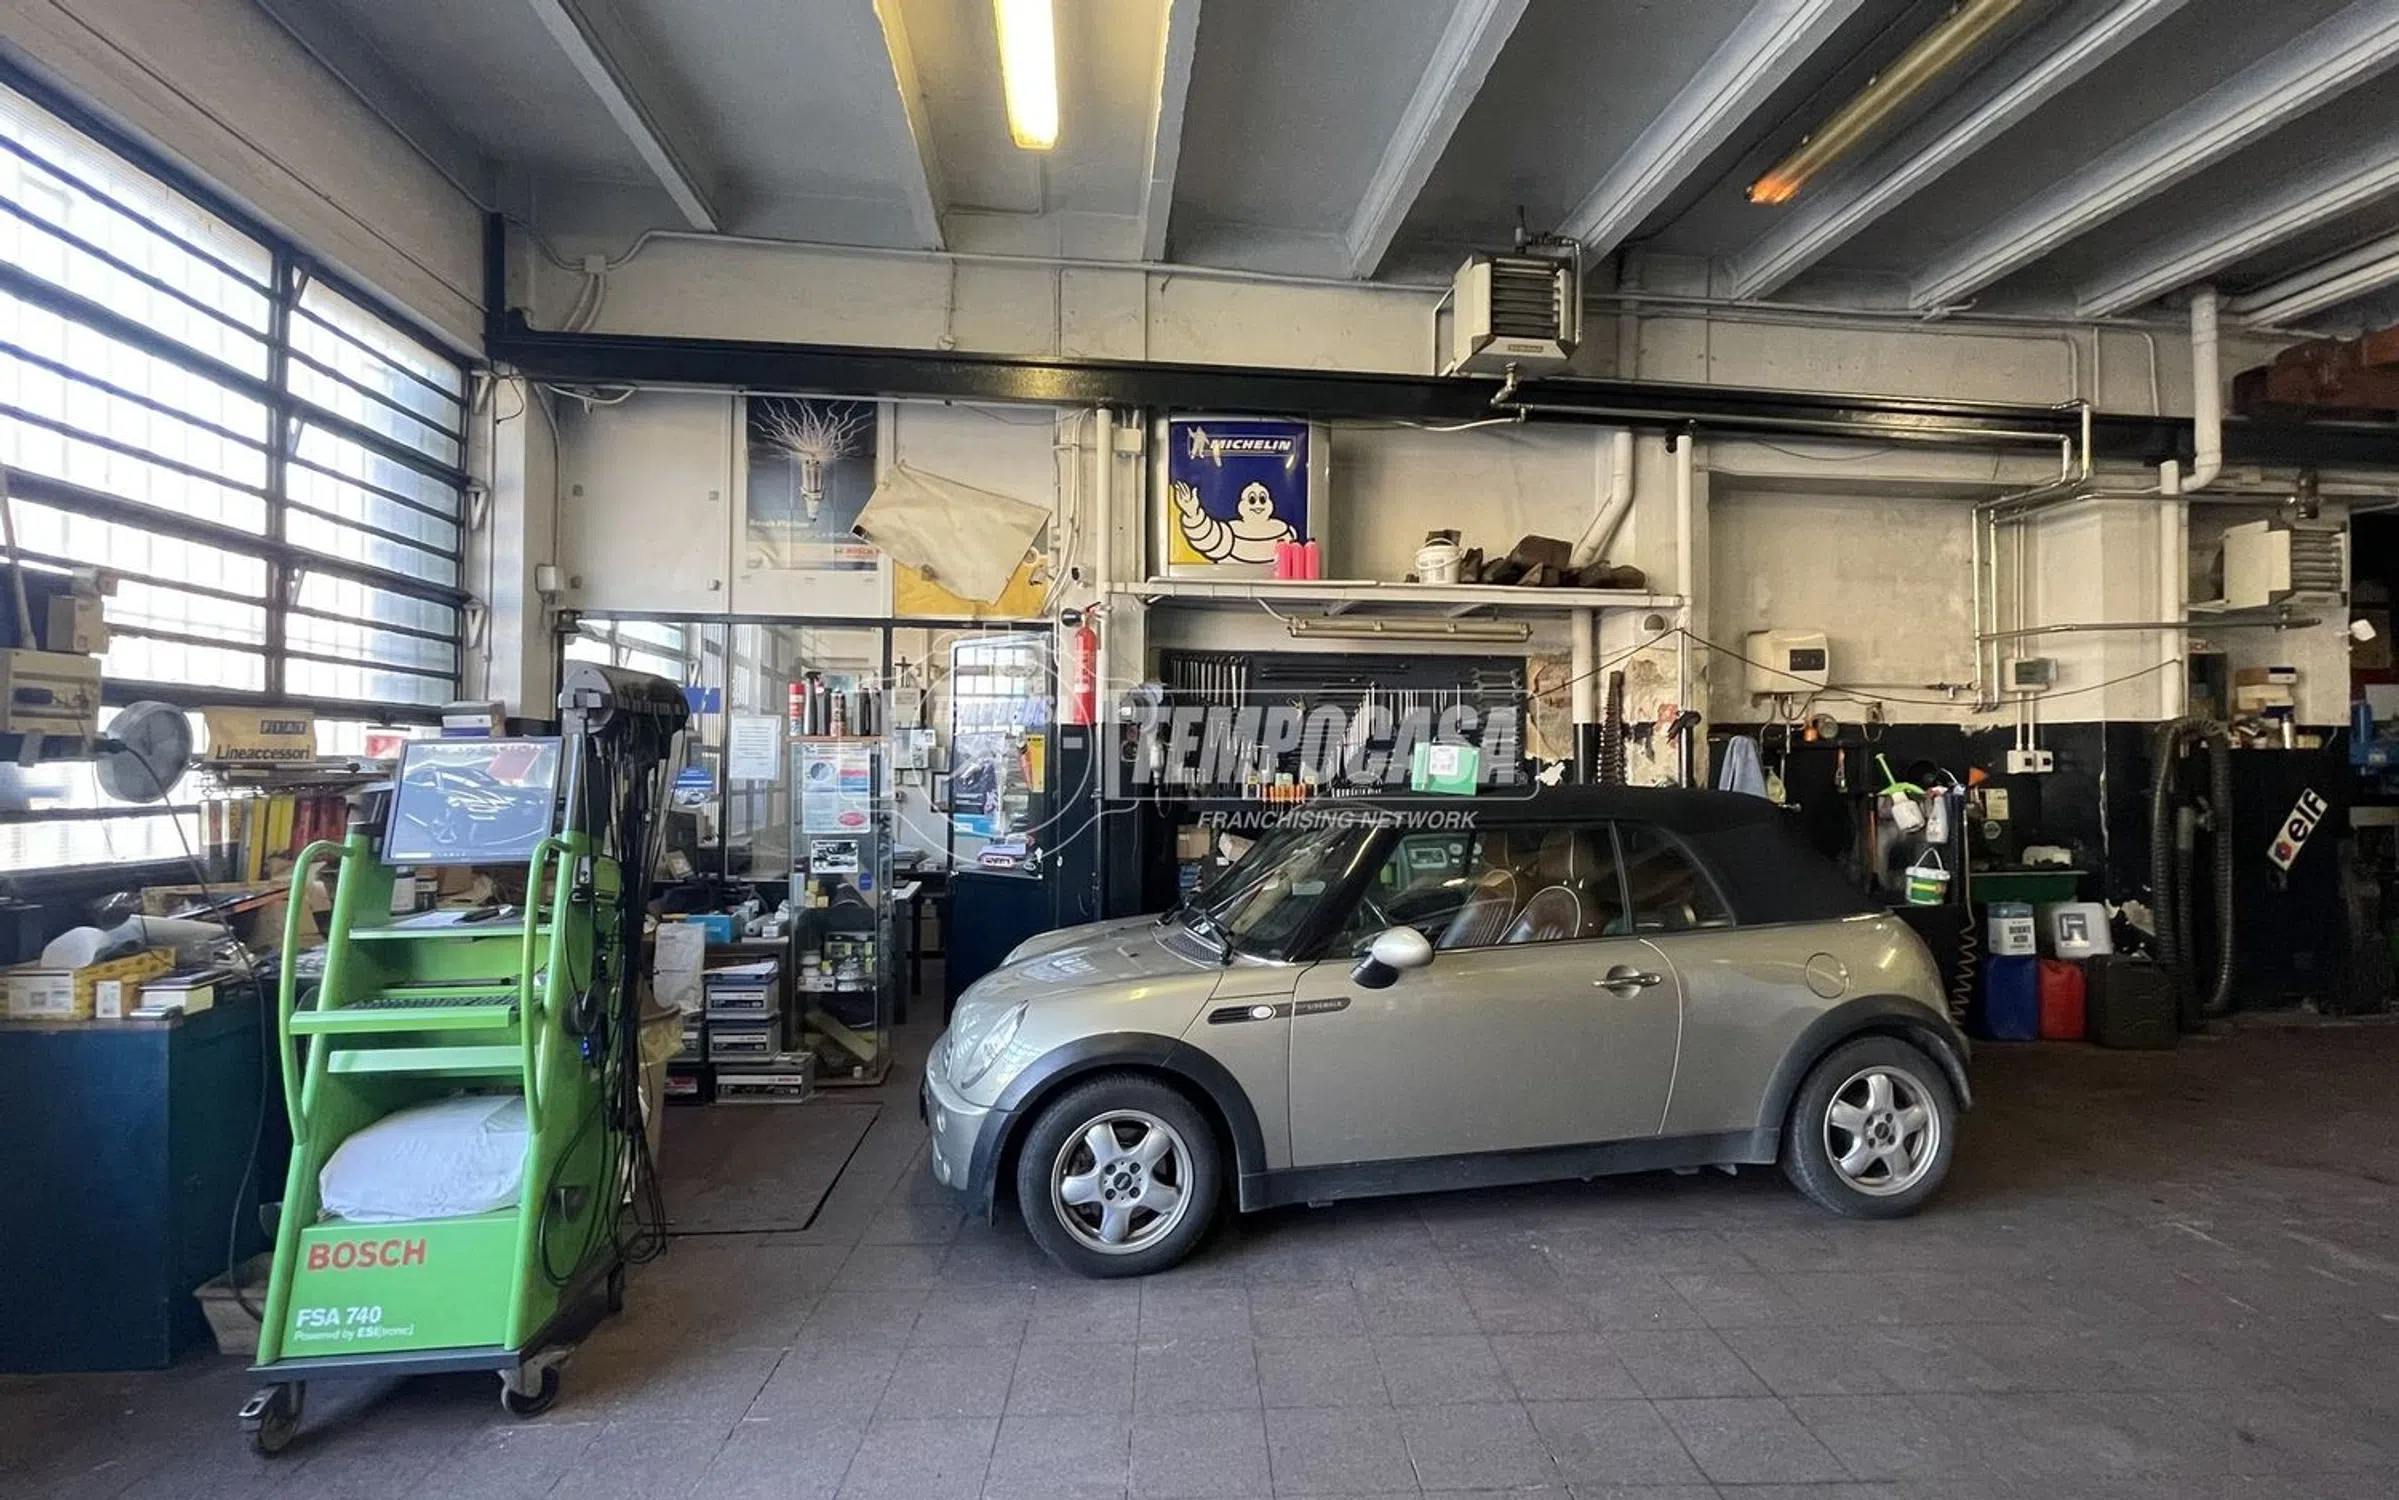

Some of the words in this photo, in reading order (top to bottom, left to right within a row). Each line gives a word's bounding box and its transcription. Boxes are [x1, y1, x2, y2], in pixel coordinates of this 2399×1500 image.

[1209, 438, 1292, 451] MICHELIN
[261, 721, 305, 734] FIAT
[215, 744, 311, 760] Lineaccessori
[2288, 790, 2321, 842] elf
[307, 1238, 427, 1271] BOSCH
[295, 1307, 340, 1328] FSA
[346, 1305, 382, 1325] 740
